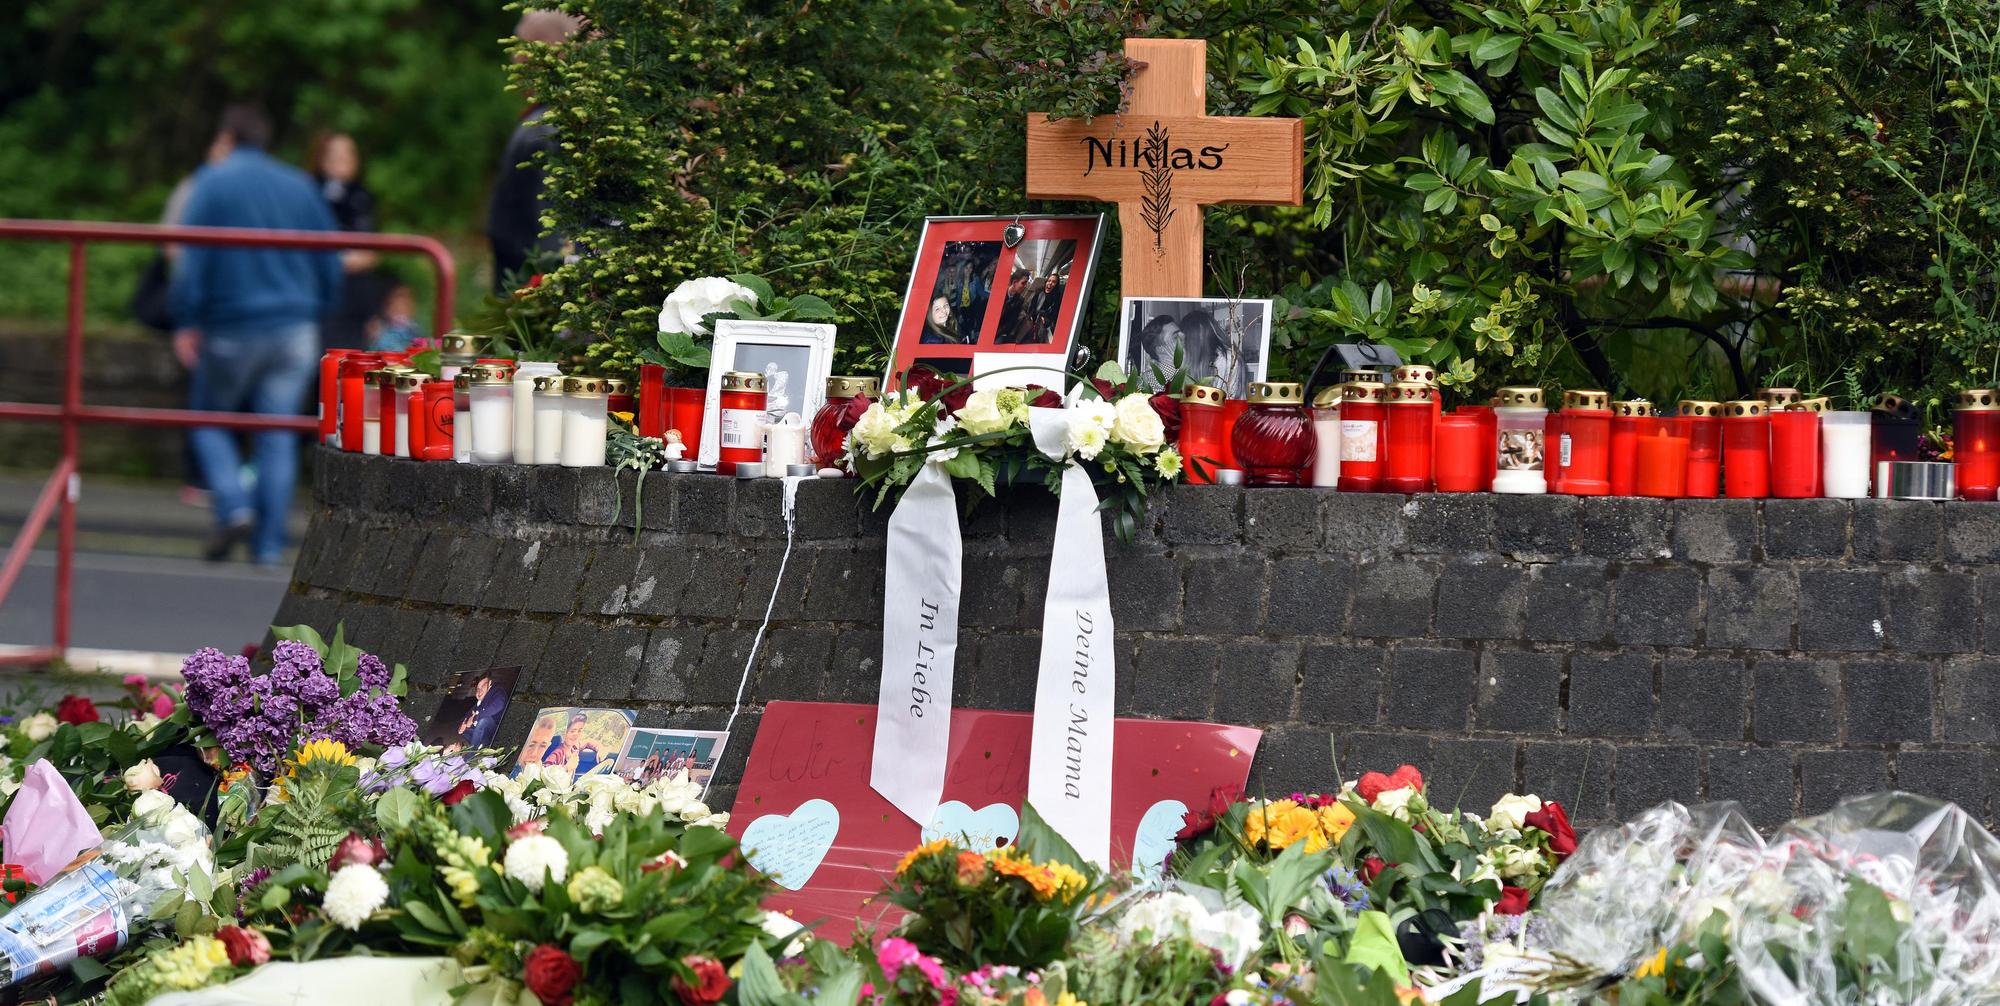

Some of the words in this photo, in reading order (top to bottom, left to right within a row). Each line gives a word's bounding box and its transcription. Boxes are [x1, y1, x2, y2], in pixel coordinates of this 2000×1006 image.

[1080, 135, 1230, 177] Niklas
[919, 597, 939, 632] In
[910, 640, 936, 718] Liebe
[1071, 609, 1096, 694] Deine
[769, 719, 843, 783] Wir
[1064, 703, 1089, 800] Mama
